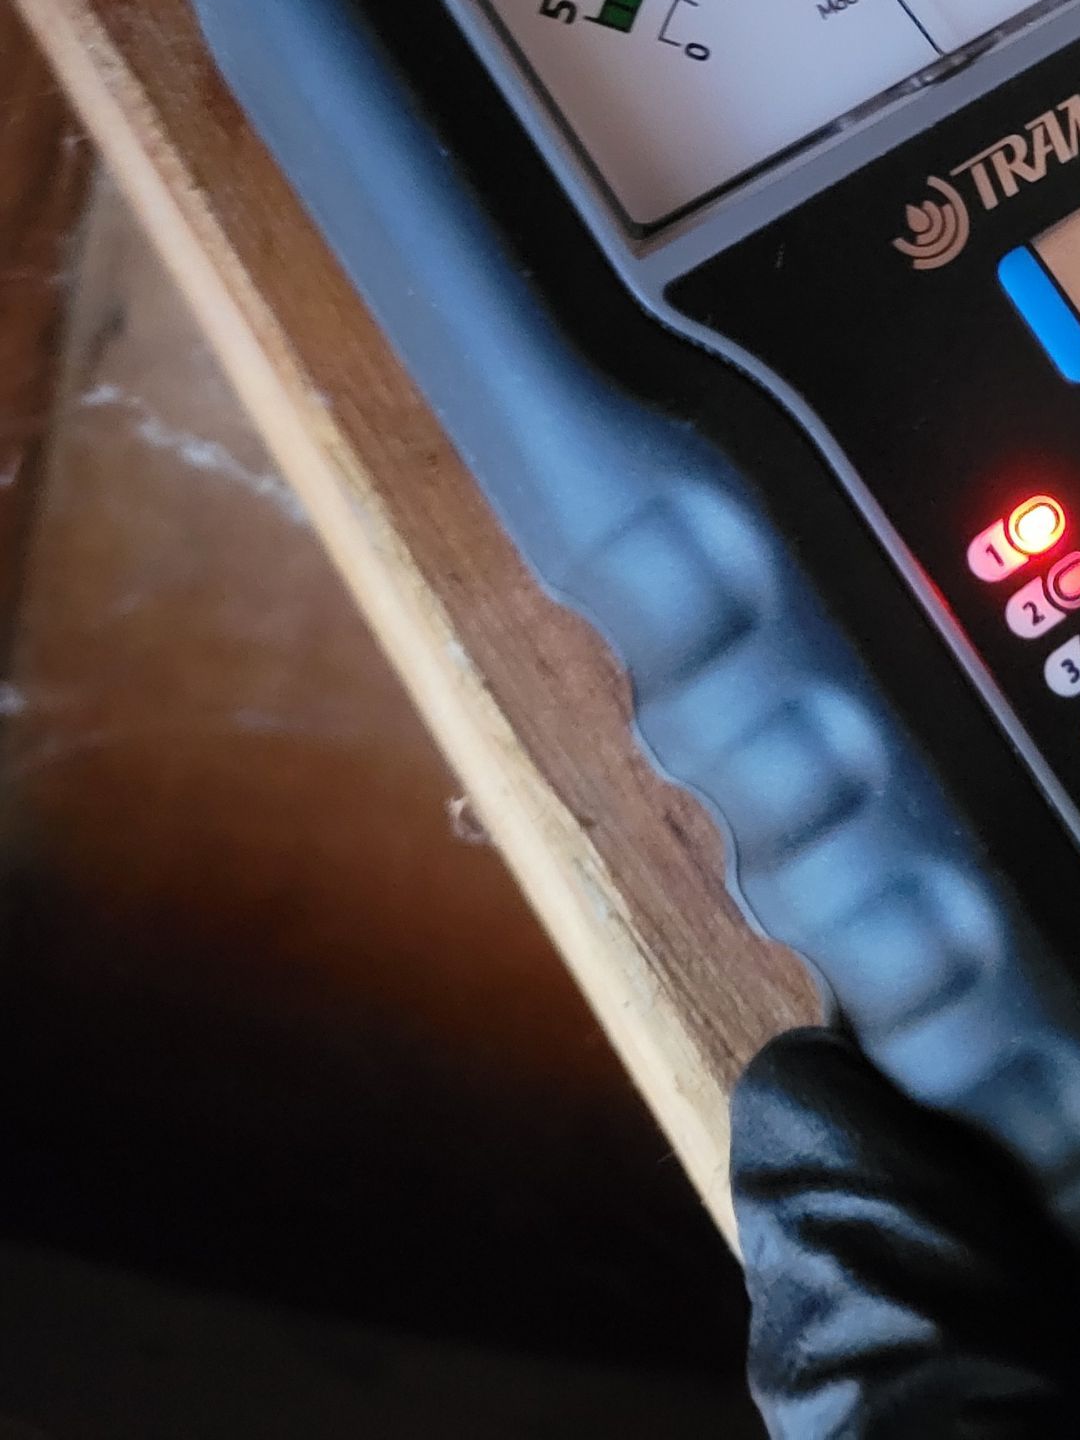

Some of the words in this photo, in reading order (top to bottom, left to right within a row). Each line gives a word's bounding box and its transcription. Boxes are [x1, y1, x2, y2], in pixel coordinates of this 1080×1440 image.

[683, 41, 711, 62] 0
[985, 542, 1007, 567] 1
[1022, 601, 1046, 626] 2
